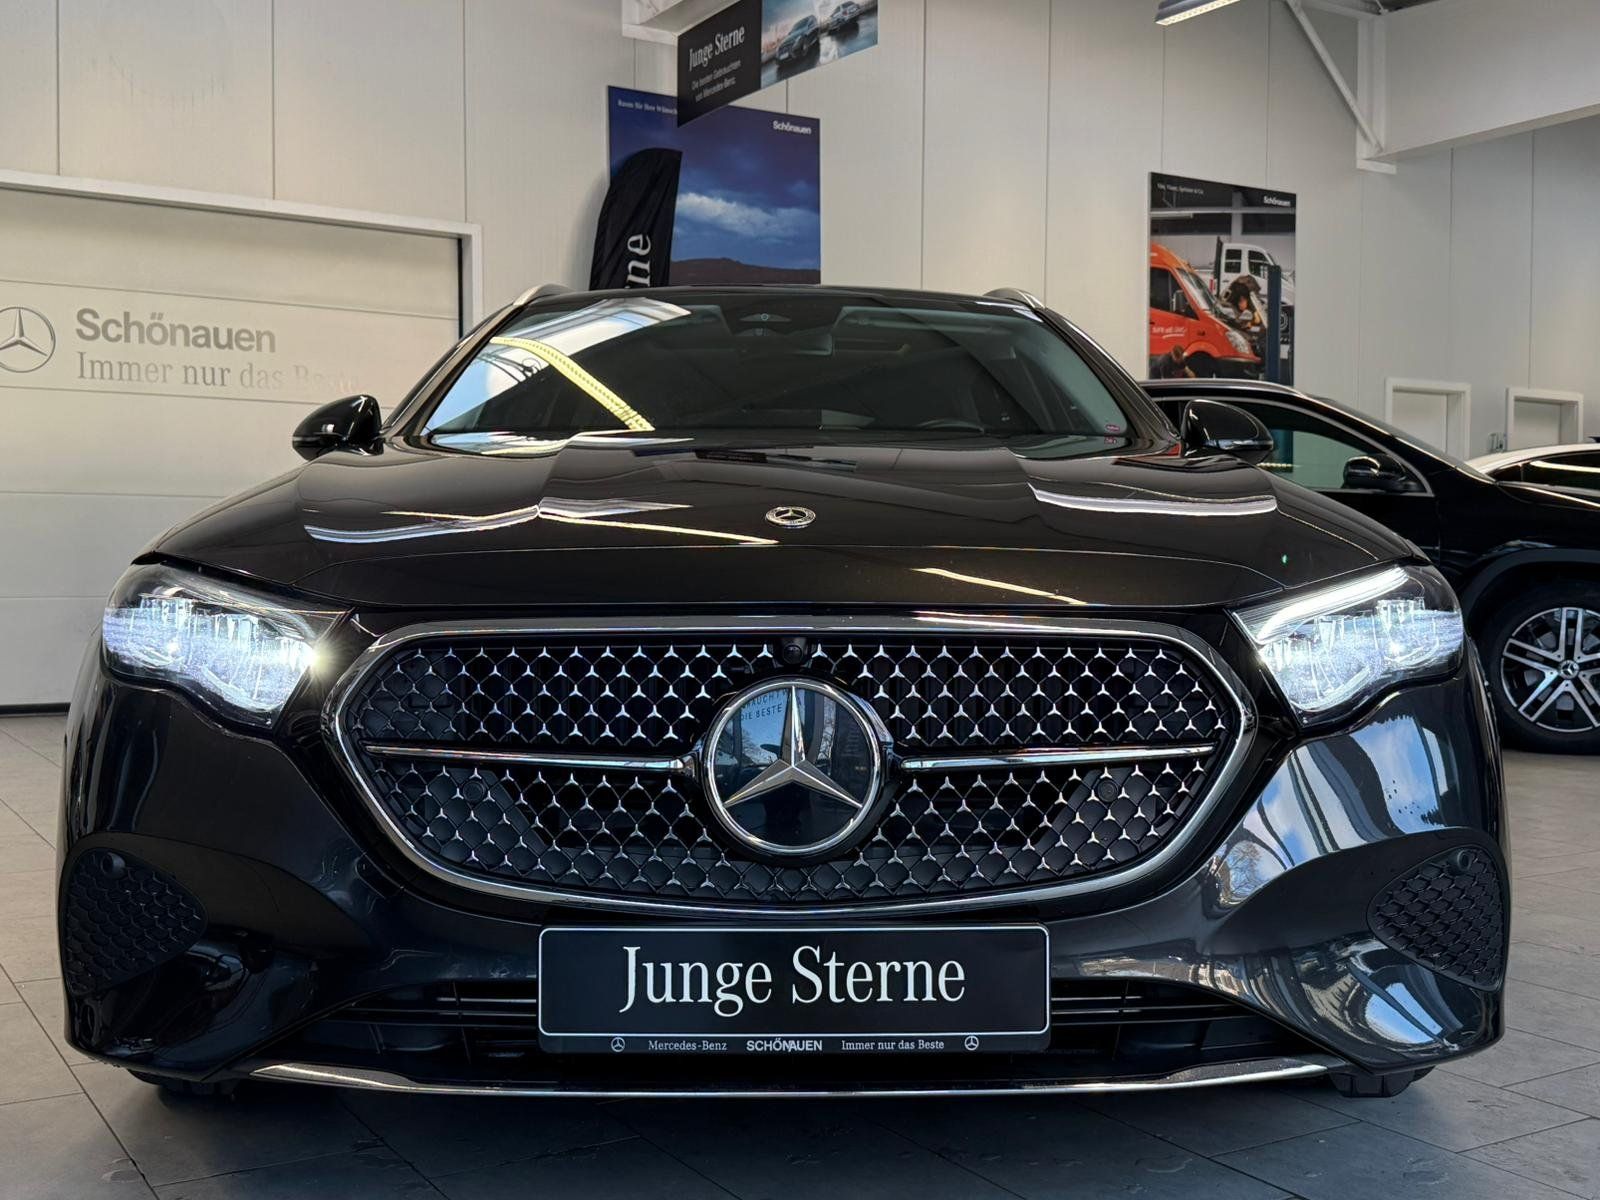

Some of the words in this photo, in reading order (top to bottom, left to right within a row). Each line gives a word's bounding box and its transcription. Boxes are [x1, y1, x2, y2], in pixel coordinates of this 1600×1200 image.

[689, 43, 713, 72] Junge
[714, 25, 745, 56] Sterne
[772, 119, 812, 136] Schönauen
[624, 233, 652, 289] ne
[76, 307, 276, 353] Schönauen
[77, 351, 174, 384] Immer
[182, 365, 231, 388] nur
[239, 362, 285, 391] das
[755, 703, 783, 718] BESTE
[619, 945, 773, 1018] Junge
[791, 944, 967, 1005] Sterne
[648, 1039, 728, 1052] Mercedes-Benz
[746, 1037, 823, 1052] SCHÖNAUEN
[841, 1039, 875, 1051] Immer
[877, 1041, 895, 1051] nur
[897, 1039, 915, 1051] das
[917, 1039, 944, 1051] Beste
